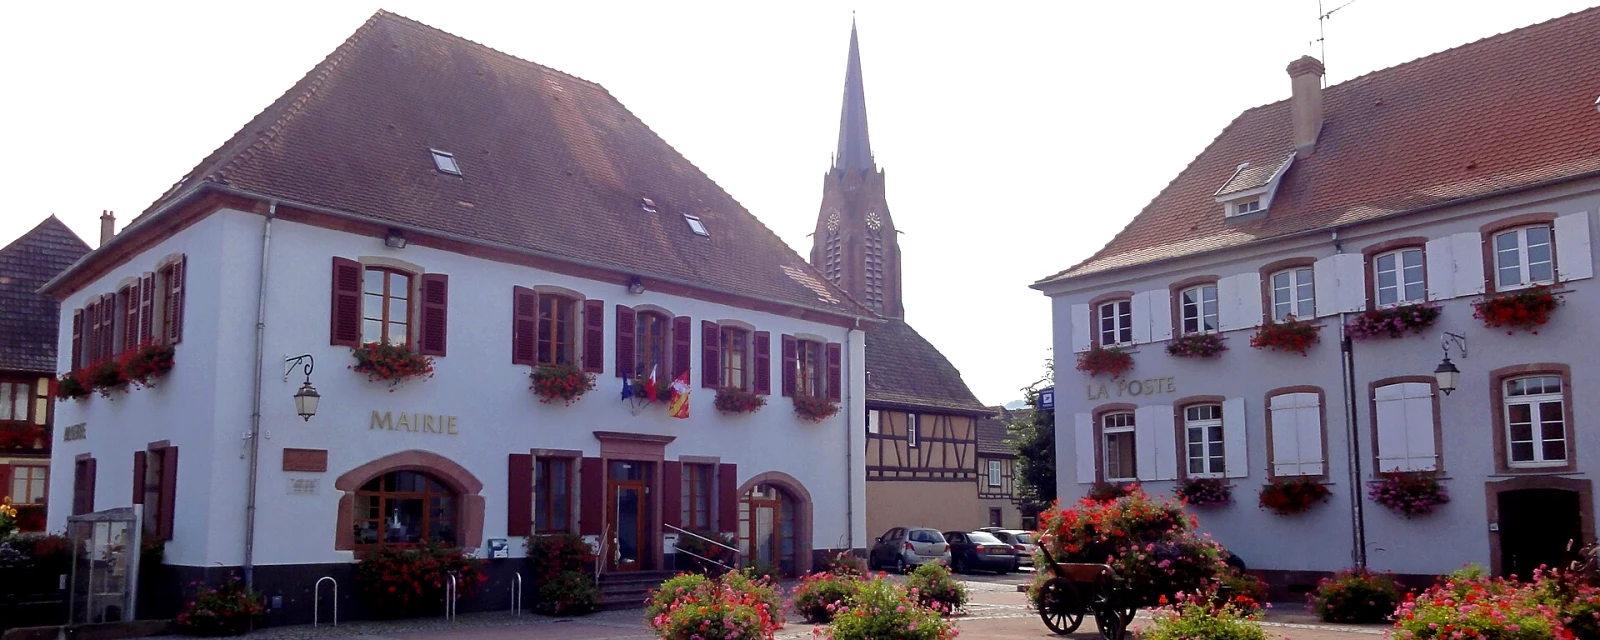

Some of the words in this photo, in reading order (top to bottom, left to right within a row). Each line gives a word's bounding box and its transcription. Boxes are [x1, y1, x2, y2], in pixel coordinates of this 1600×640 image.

[1087, 384, 1109, 400] LA
[1117, 376, 1177, 398] POSTE
[369, 410, 460, 435] MAIRIE
